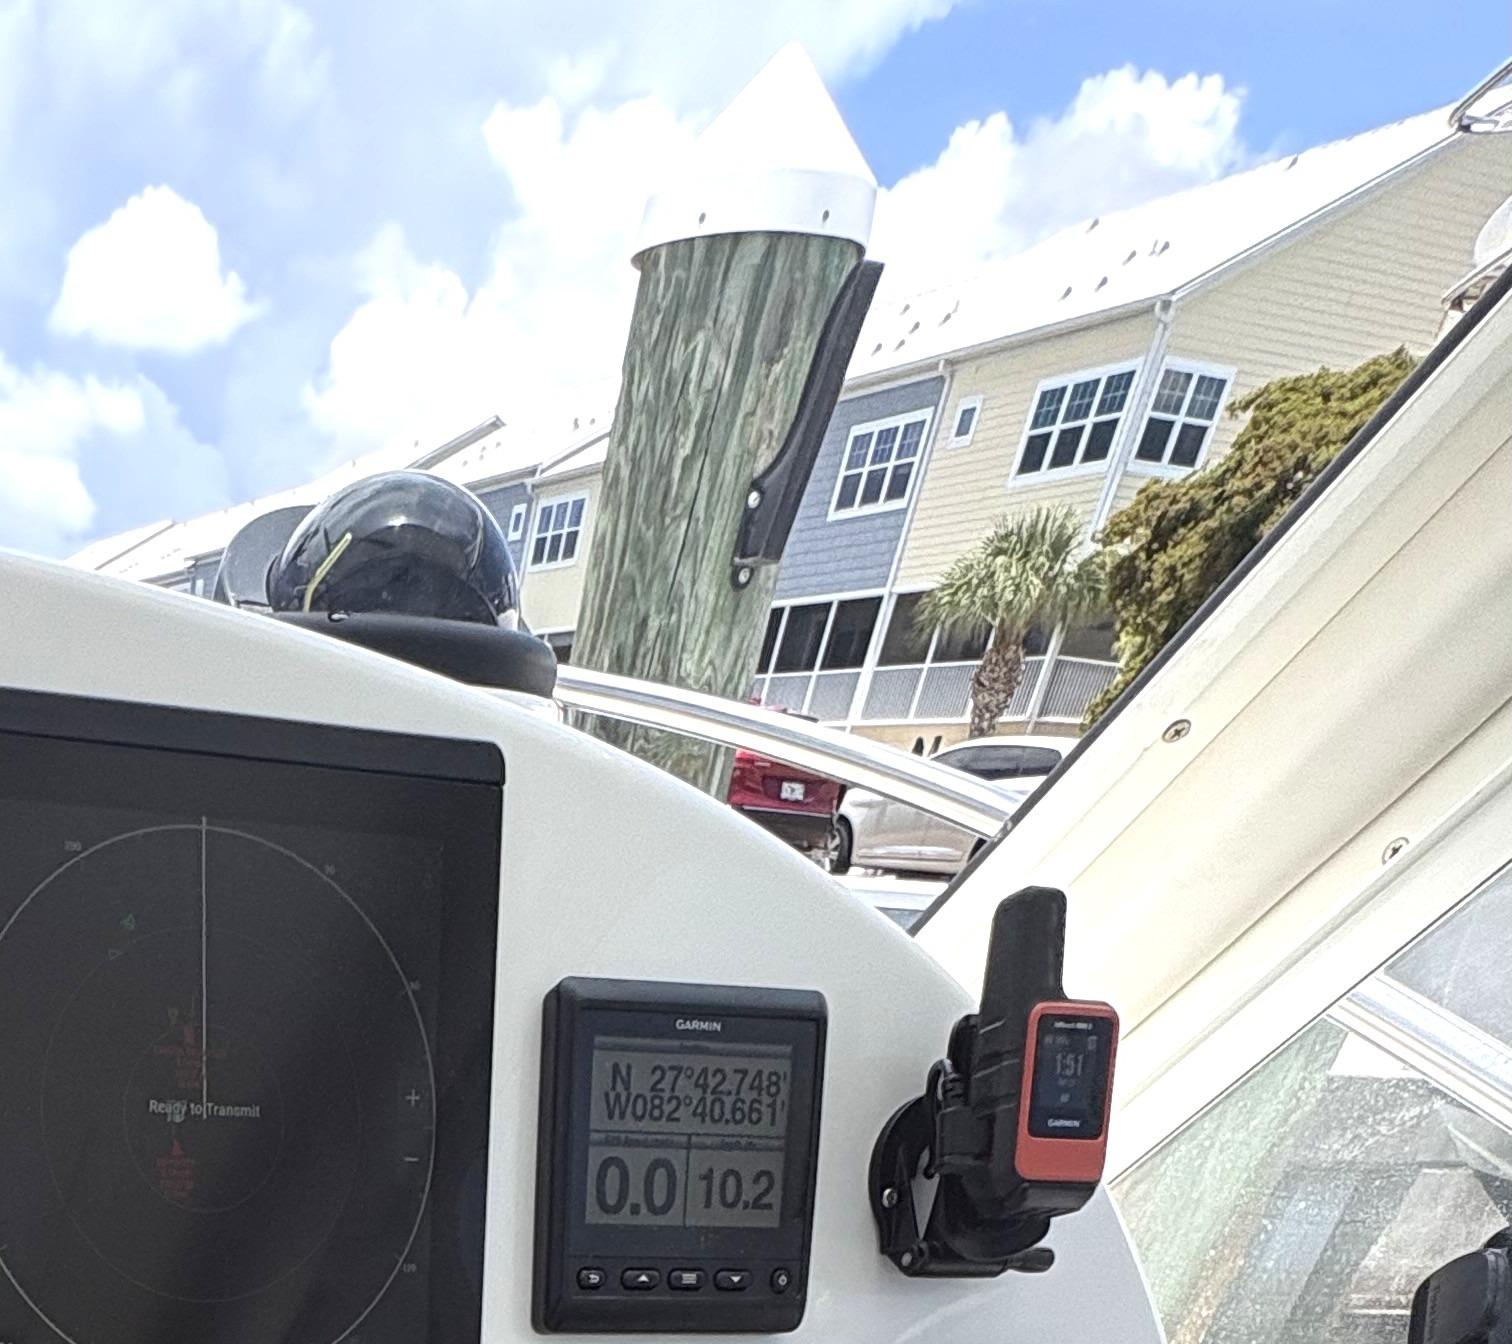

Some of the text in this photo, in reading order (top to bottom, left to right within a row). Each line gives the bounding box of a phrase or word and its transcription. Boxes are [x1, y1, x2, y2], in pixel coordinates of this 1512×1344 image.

[676, 1019, 722, 1032] GARMIN
[611, 1062, 632, 1092] N
[149, 1100, 261, 1118] Ready to Transmit
[596, 1156, 677, 1216] 0.0
[699, 1167, 776, 1210] 10.2
